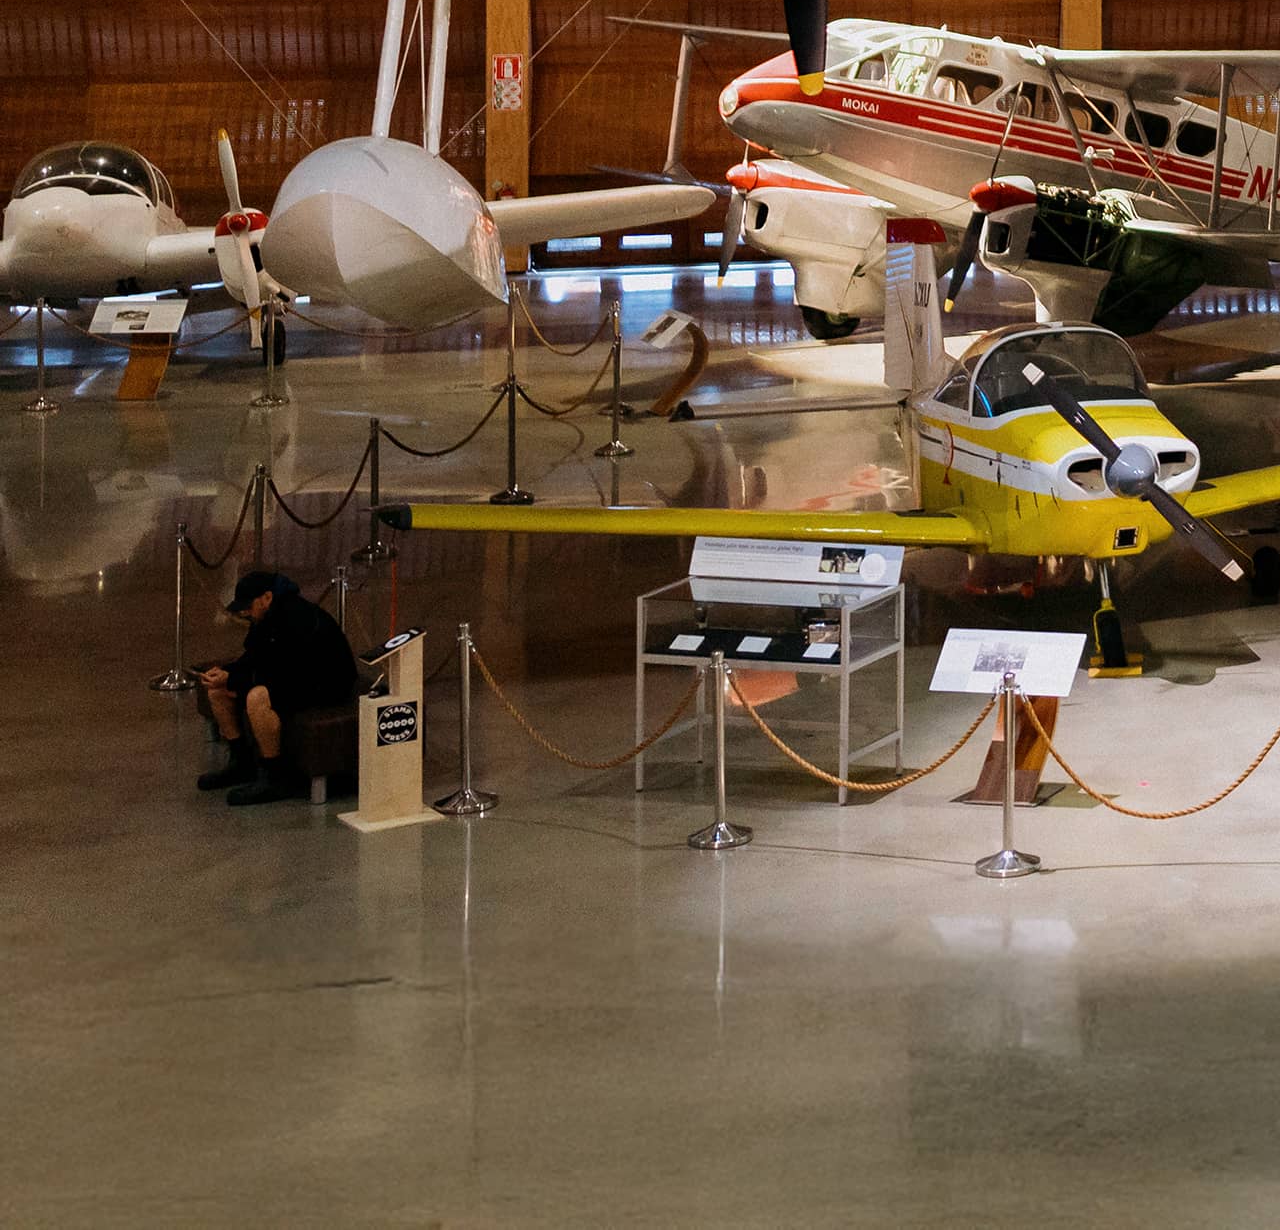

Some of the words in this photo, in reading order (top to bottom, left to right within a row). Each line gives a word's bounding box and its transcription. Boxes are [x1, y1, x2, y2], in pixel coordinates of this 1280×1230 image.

[841, 97, 880, 115] MOKAI
[384, 707, 411, 718] STAMP
[385, 730, 410, 741] PRESS
